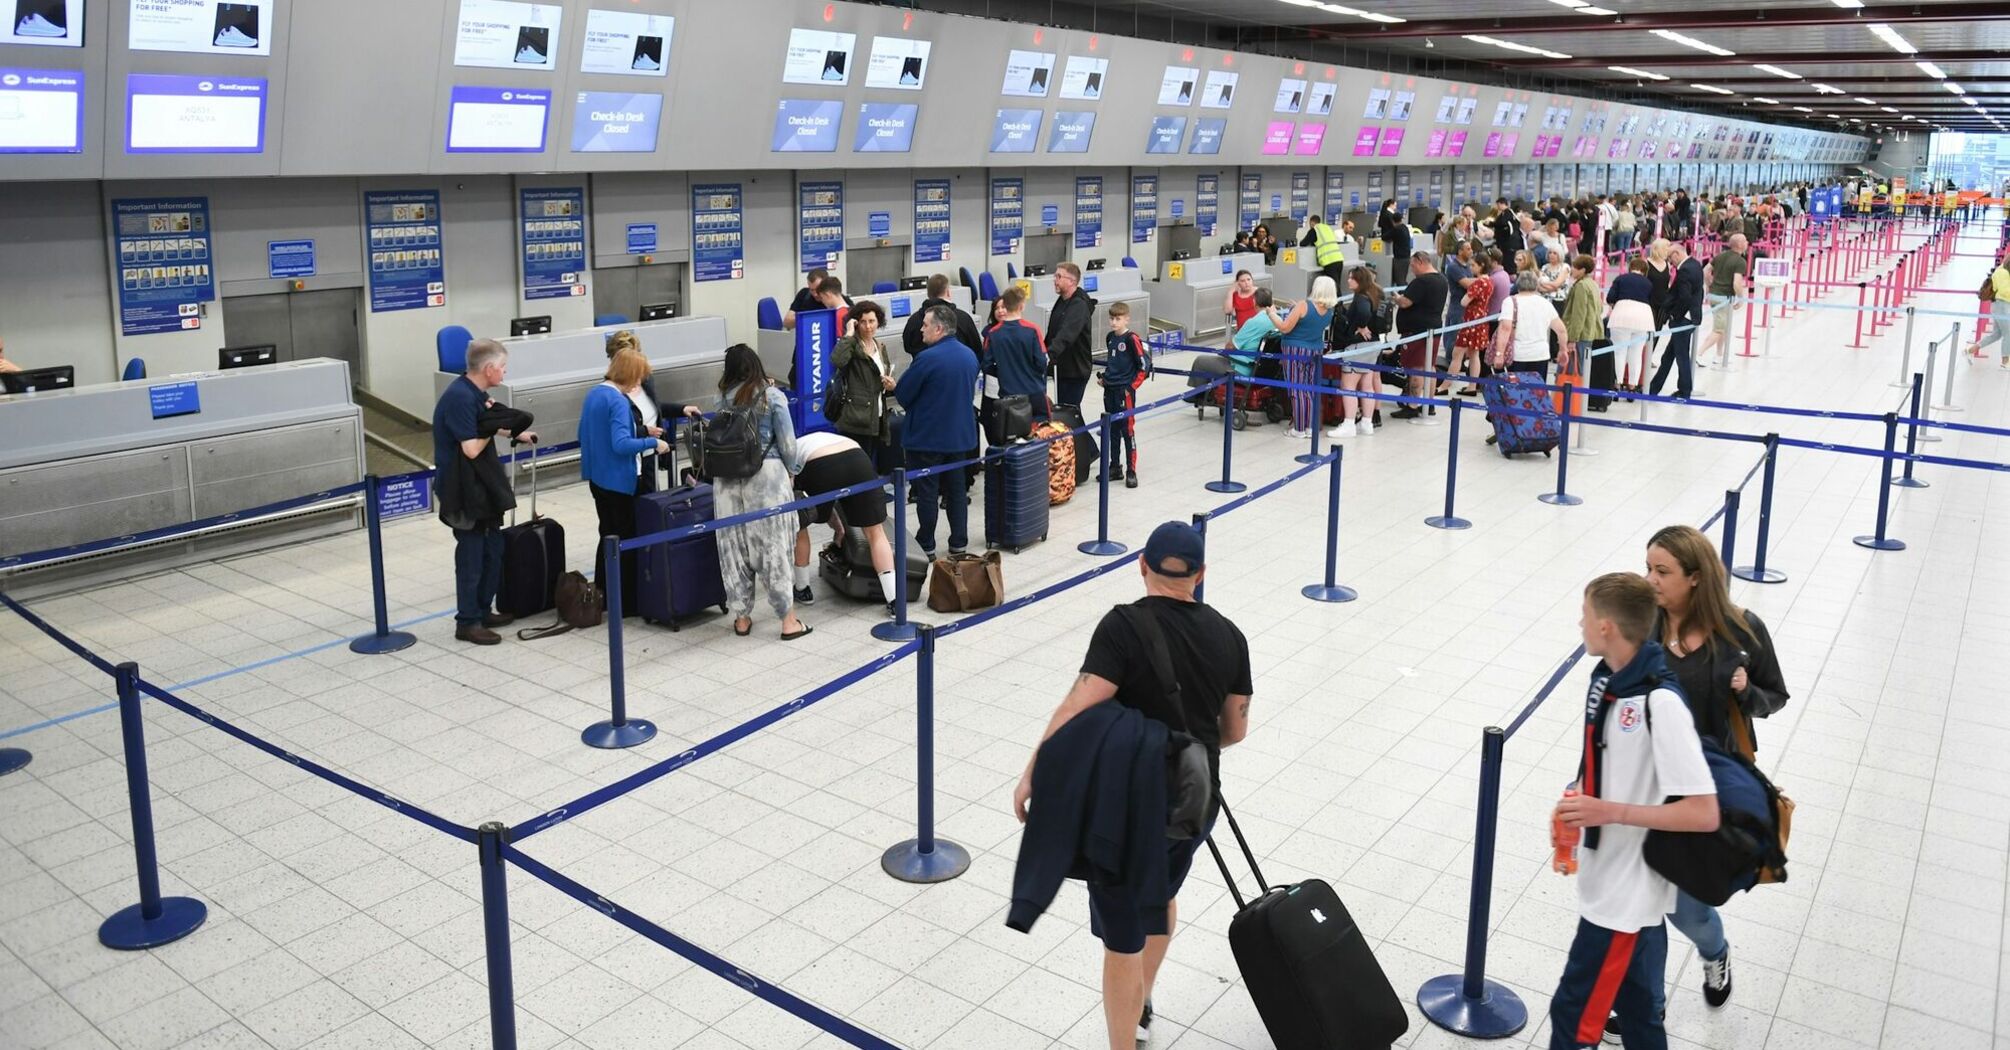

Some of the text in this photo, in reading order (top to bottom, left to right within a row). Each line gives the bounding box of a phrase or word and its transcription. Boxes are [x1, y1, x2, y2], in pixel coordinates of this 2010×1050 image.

[26, 76, 77, 86] SunExpress
[218, 83, 260, 91] SunExpress
[625, 111, 645, 121] Desk
[603, 124, 630, 133] Closed
[118, 203, 156, 211] Important
[812, 322, 821, 394] RYANAIR
[387, 480, 414, 491] NOTICE
